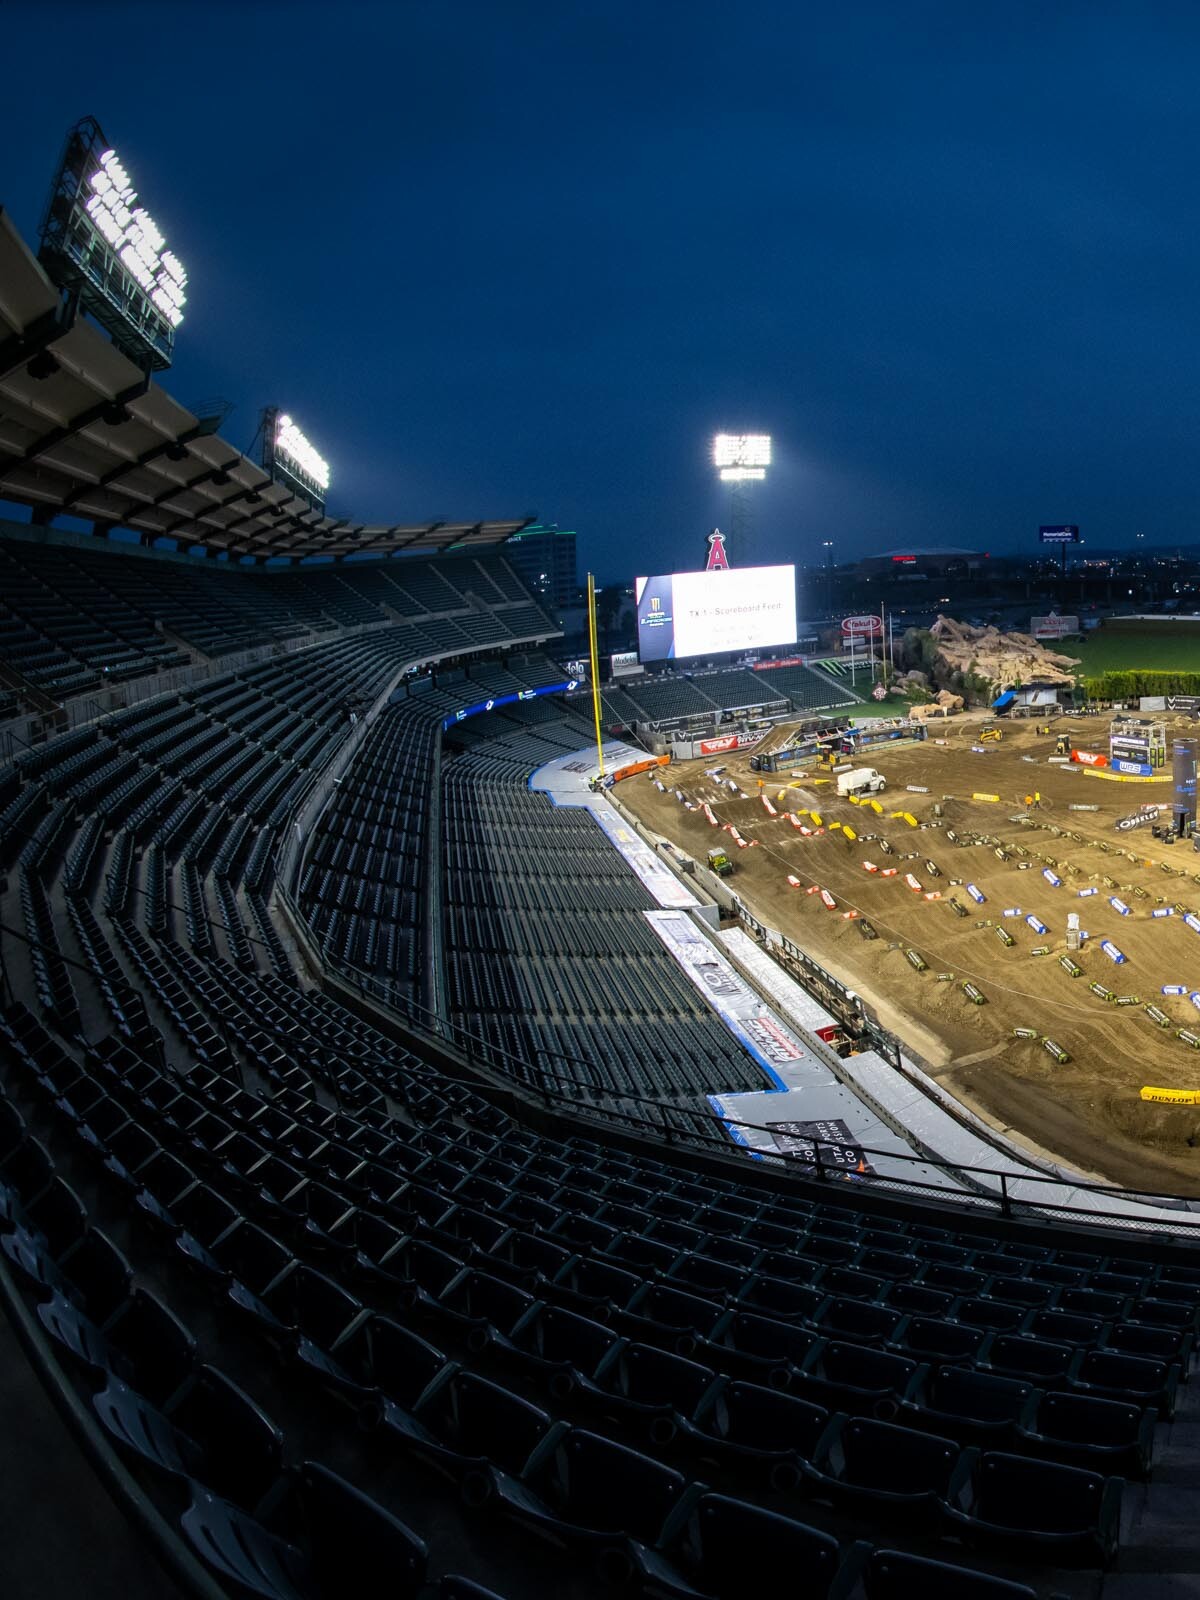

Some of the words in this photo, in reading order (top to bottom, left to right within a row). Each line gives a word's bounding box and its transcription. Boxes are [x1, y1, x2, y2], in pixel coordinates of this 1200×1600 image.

[715, 604, 760, 616] Scoreboard
[762, 602, 781, 611] Feed
[1151, 1095, 1192, 1104] DUNLOP
[816, 1122, 832, 1141] PORTS
